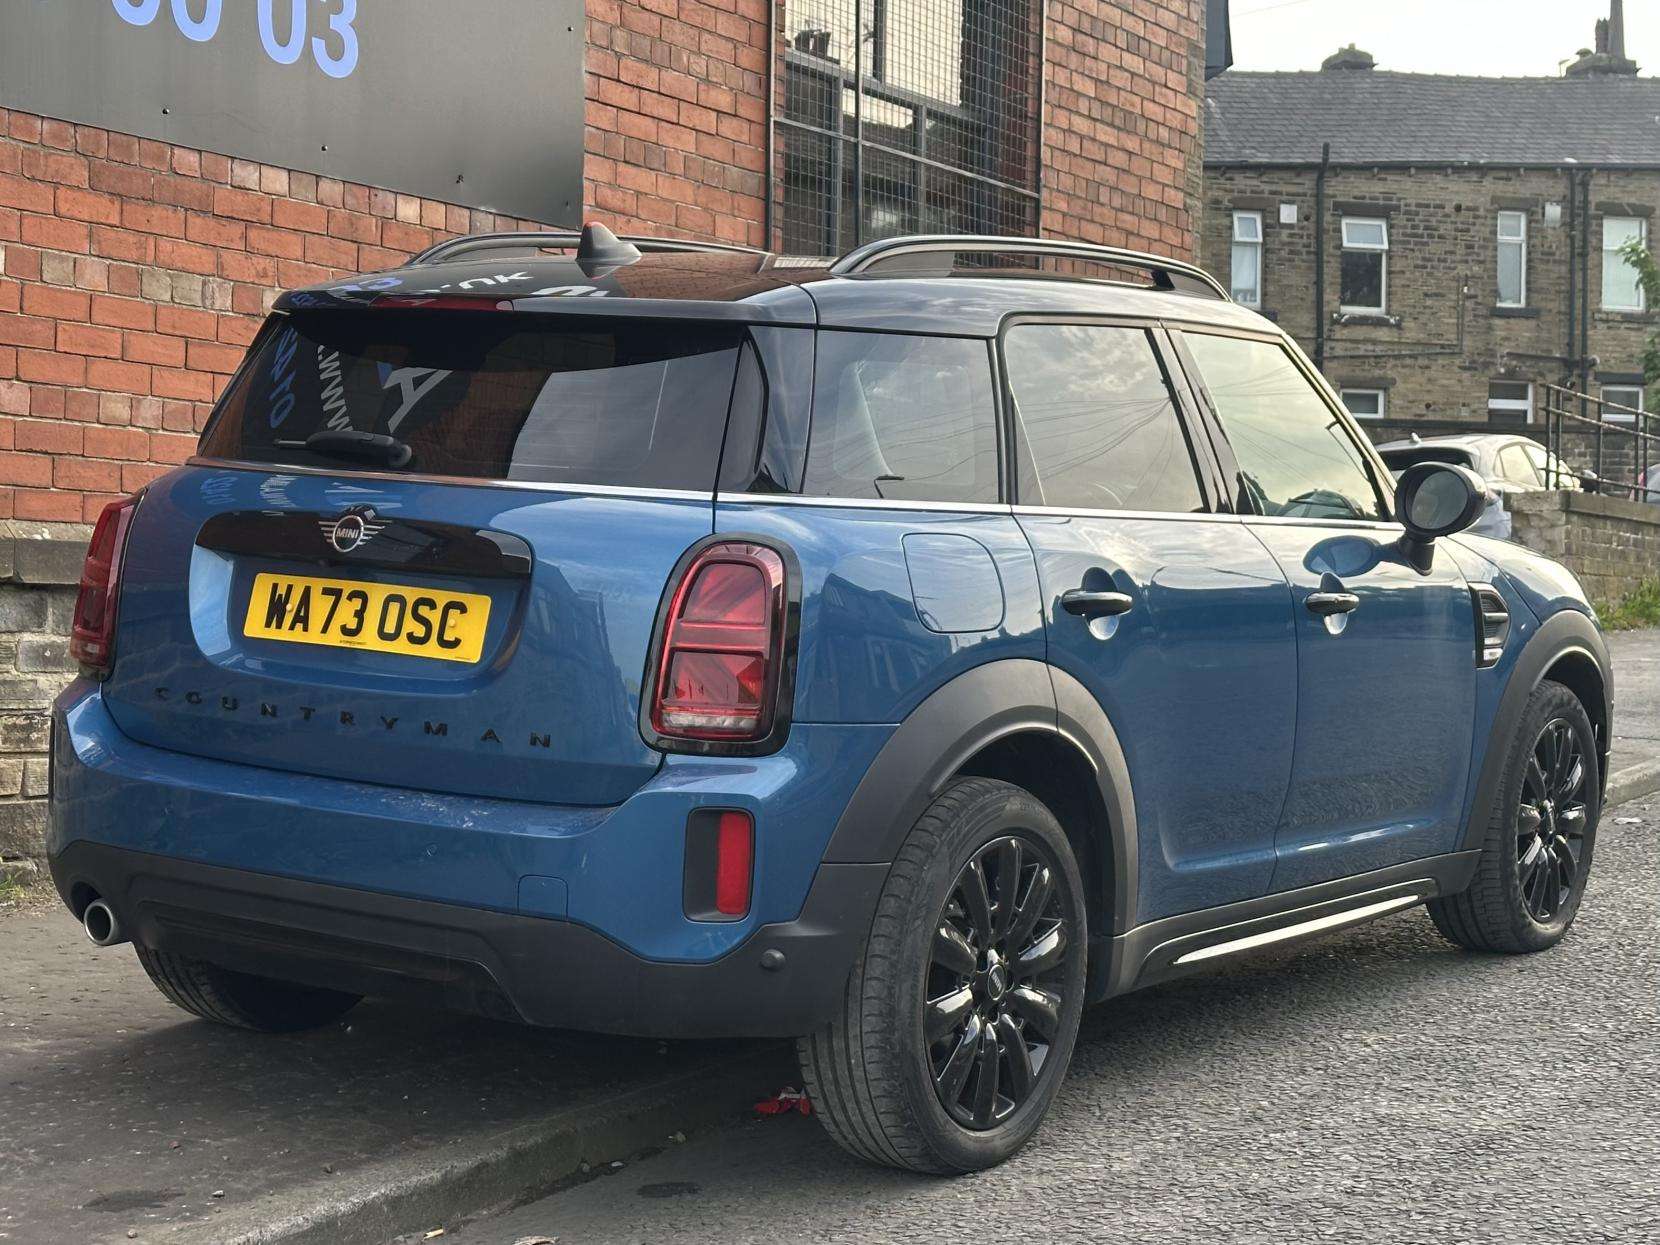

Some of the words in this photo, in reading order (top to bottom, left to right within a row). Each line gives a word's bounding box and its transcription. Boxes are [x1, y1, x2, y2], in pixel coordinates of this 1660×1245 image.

[335, 527, 360, 539] MINI
[264, 582, 369, 638] WA73
[376, 595, 468, 649] OSC
[155, 687, 551, 748] COUNTRYMAN
